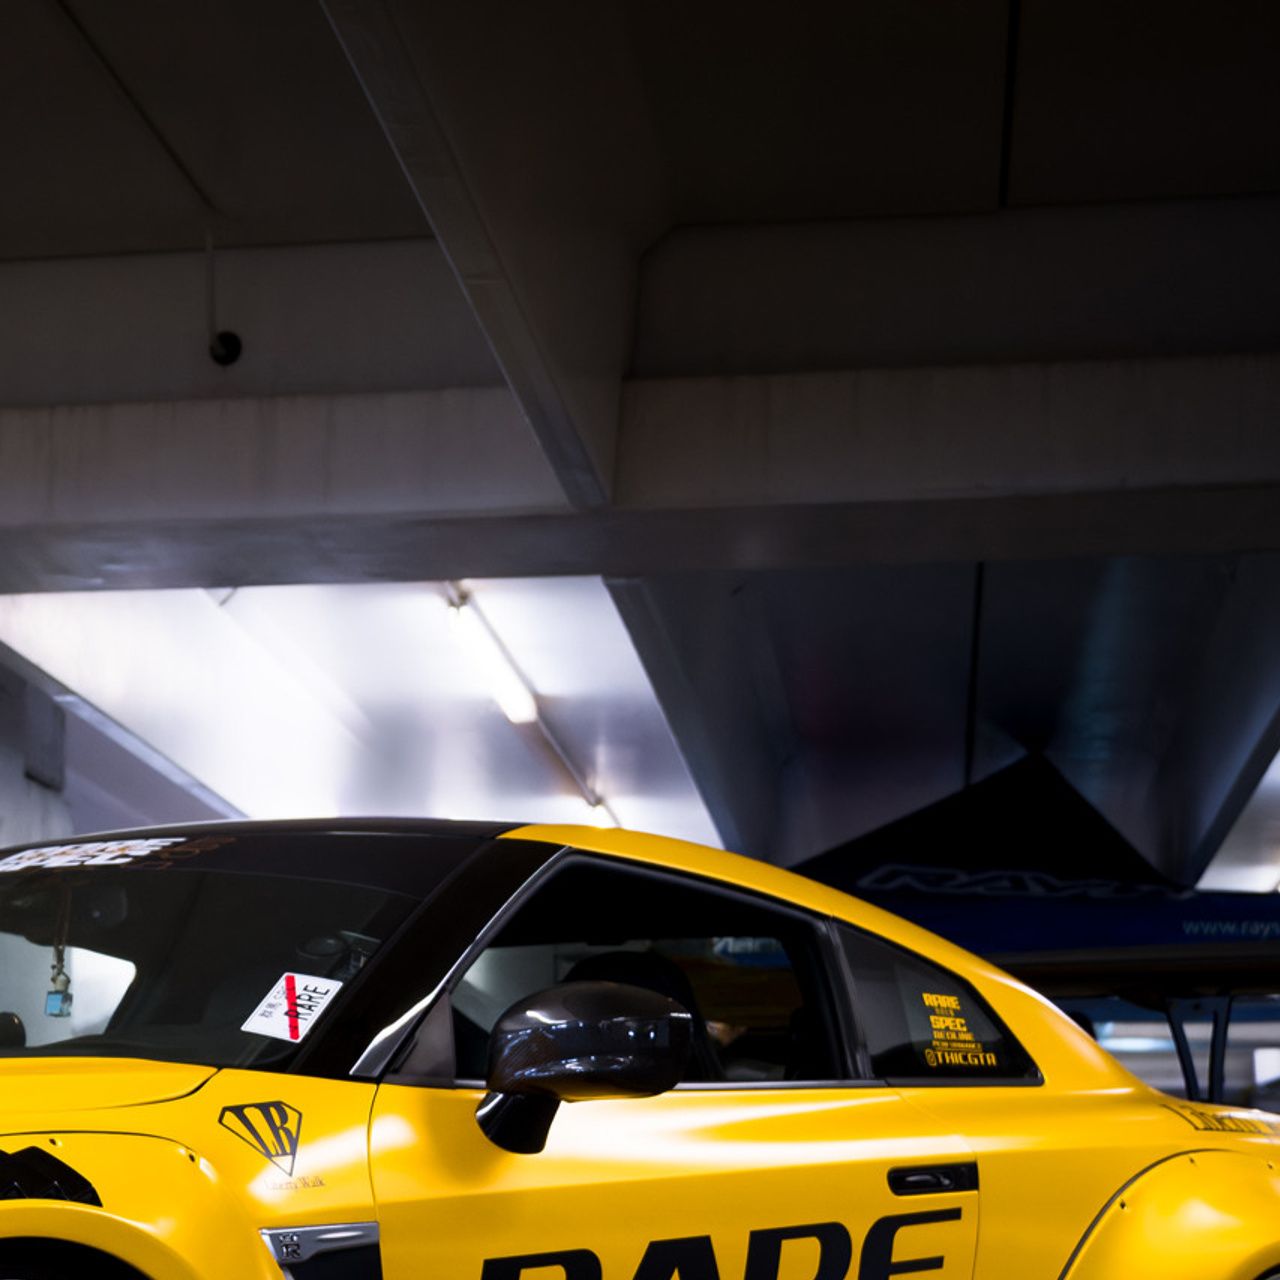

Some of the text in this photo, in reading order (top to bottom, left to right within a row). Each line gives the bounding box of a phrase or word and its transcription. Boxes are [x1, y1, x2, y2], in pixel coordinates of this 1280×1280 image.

[283, 984, 331, 1021] RARE
[922, 993, 961, 1010] RARE
[929, 1015, 968, 1032] SPEC
